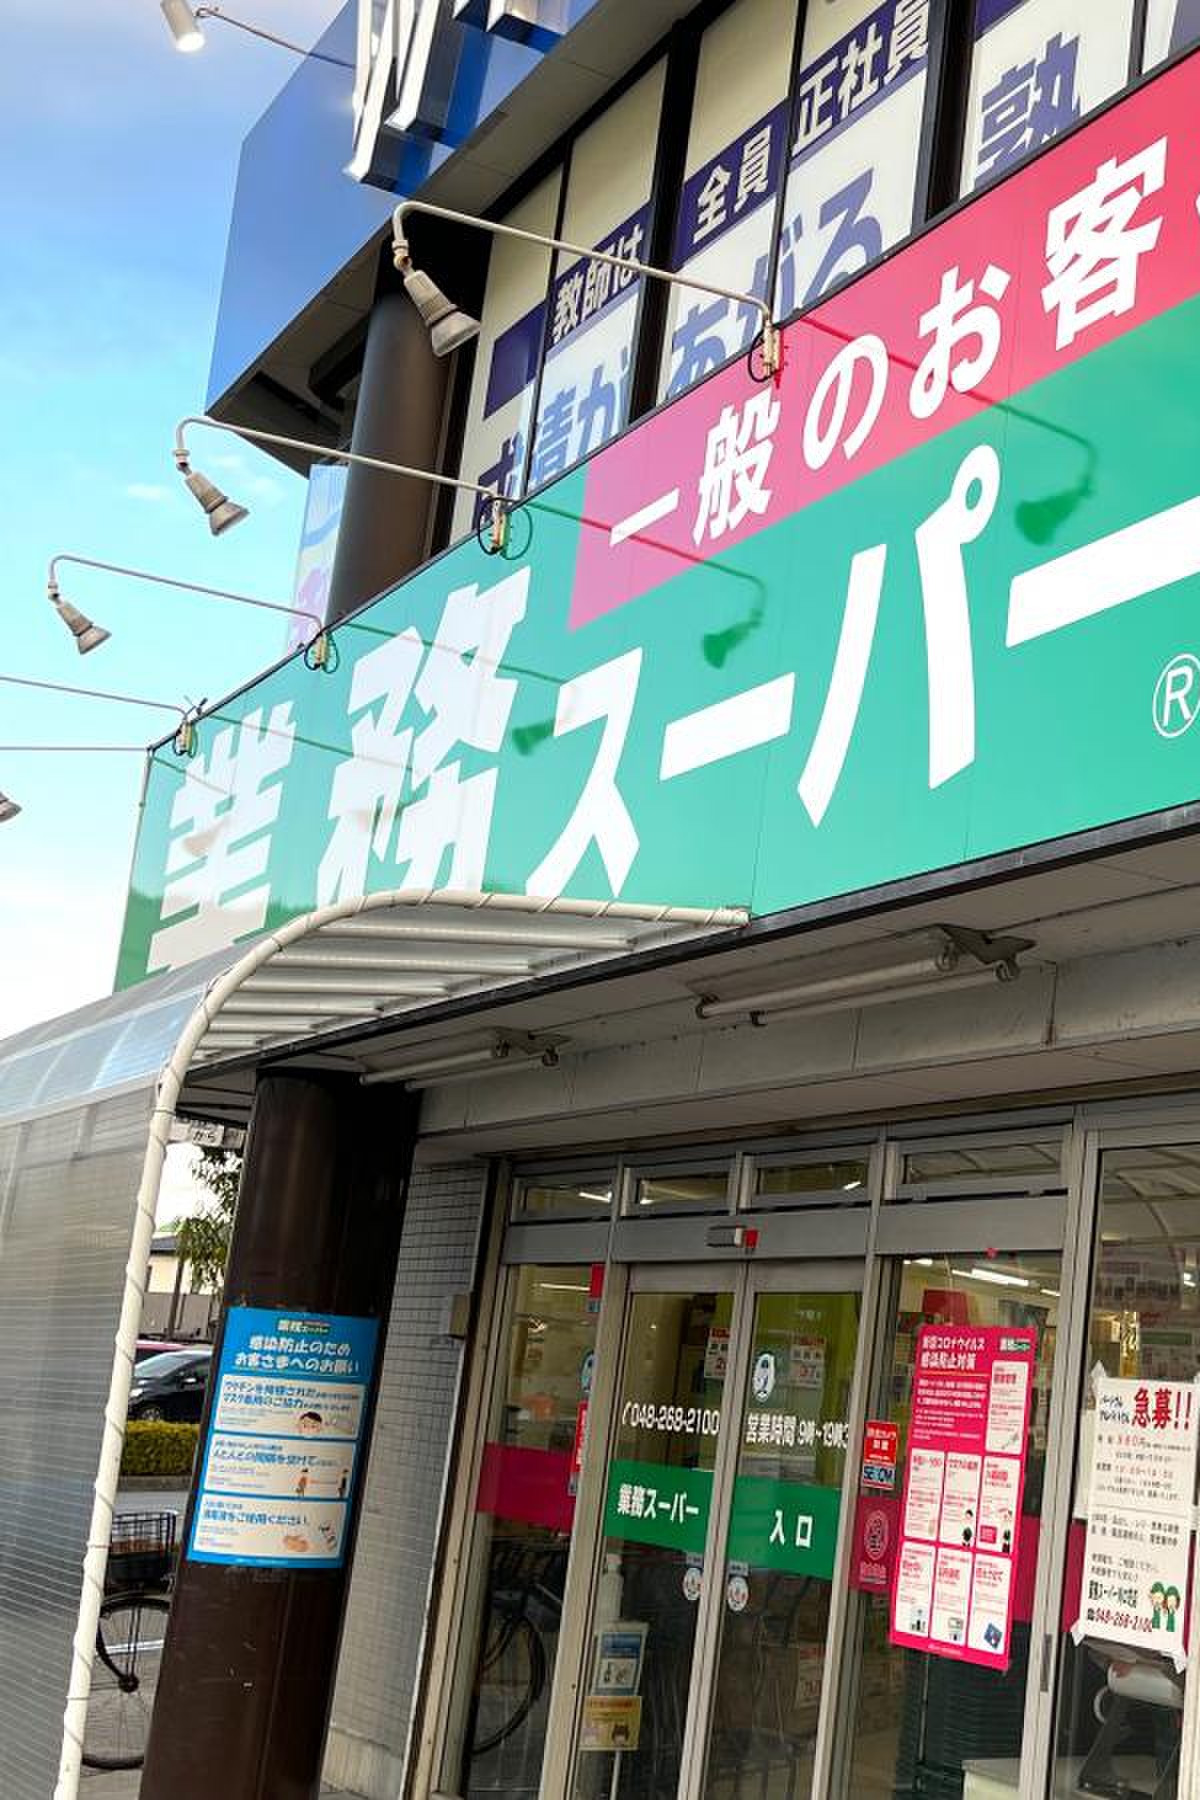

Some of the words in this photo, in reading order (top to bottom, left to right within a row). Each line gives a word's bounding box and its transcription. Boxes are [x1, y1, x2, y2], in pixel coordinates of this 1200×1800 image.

[693, 125, 772, 245] 全員
[792, 0, 929, 157] 正社員
[631, 1402, 720, 1436] 048-268-2100
[617, 1483, 700, 1524] 業務スーパー
[769, 1509, 814, 1549] 入口
